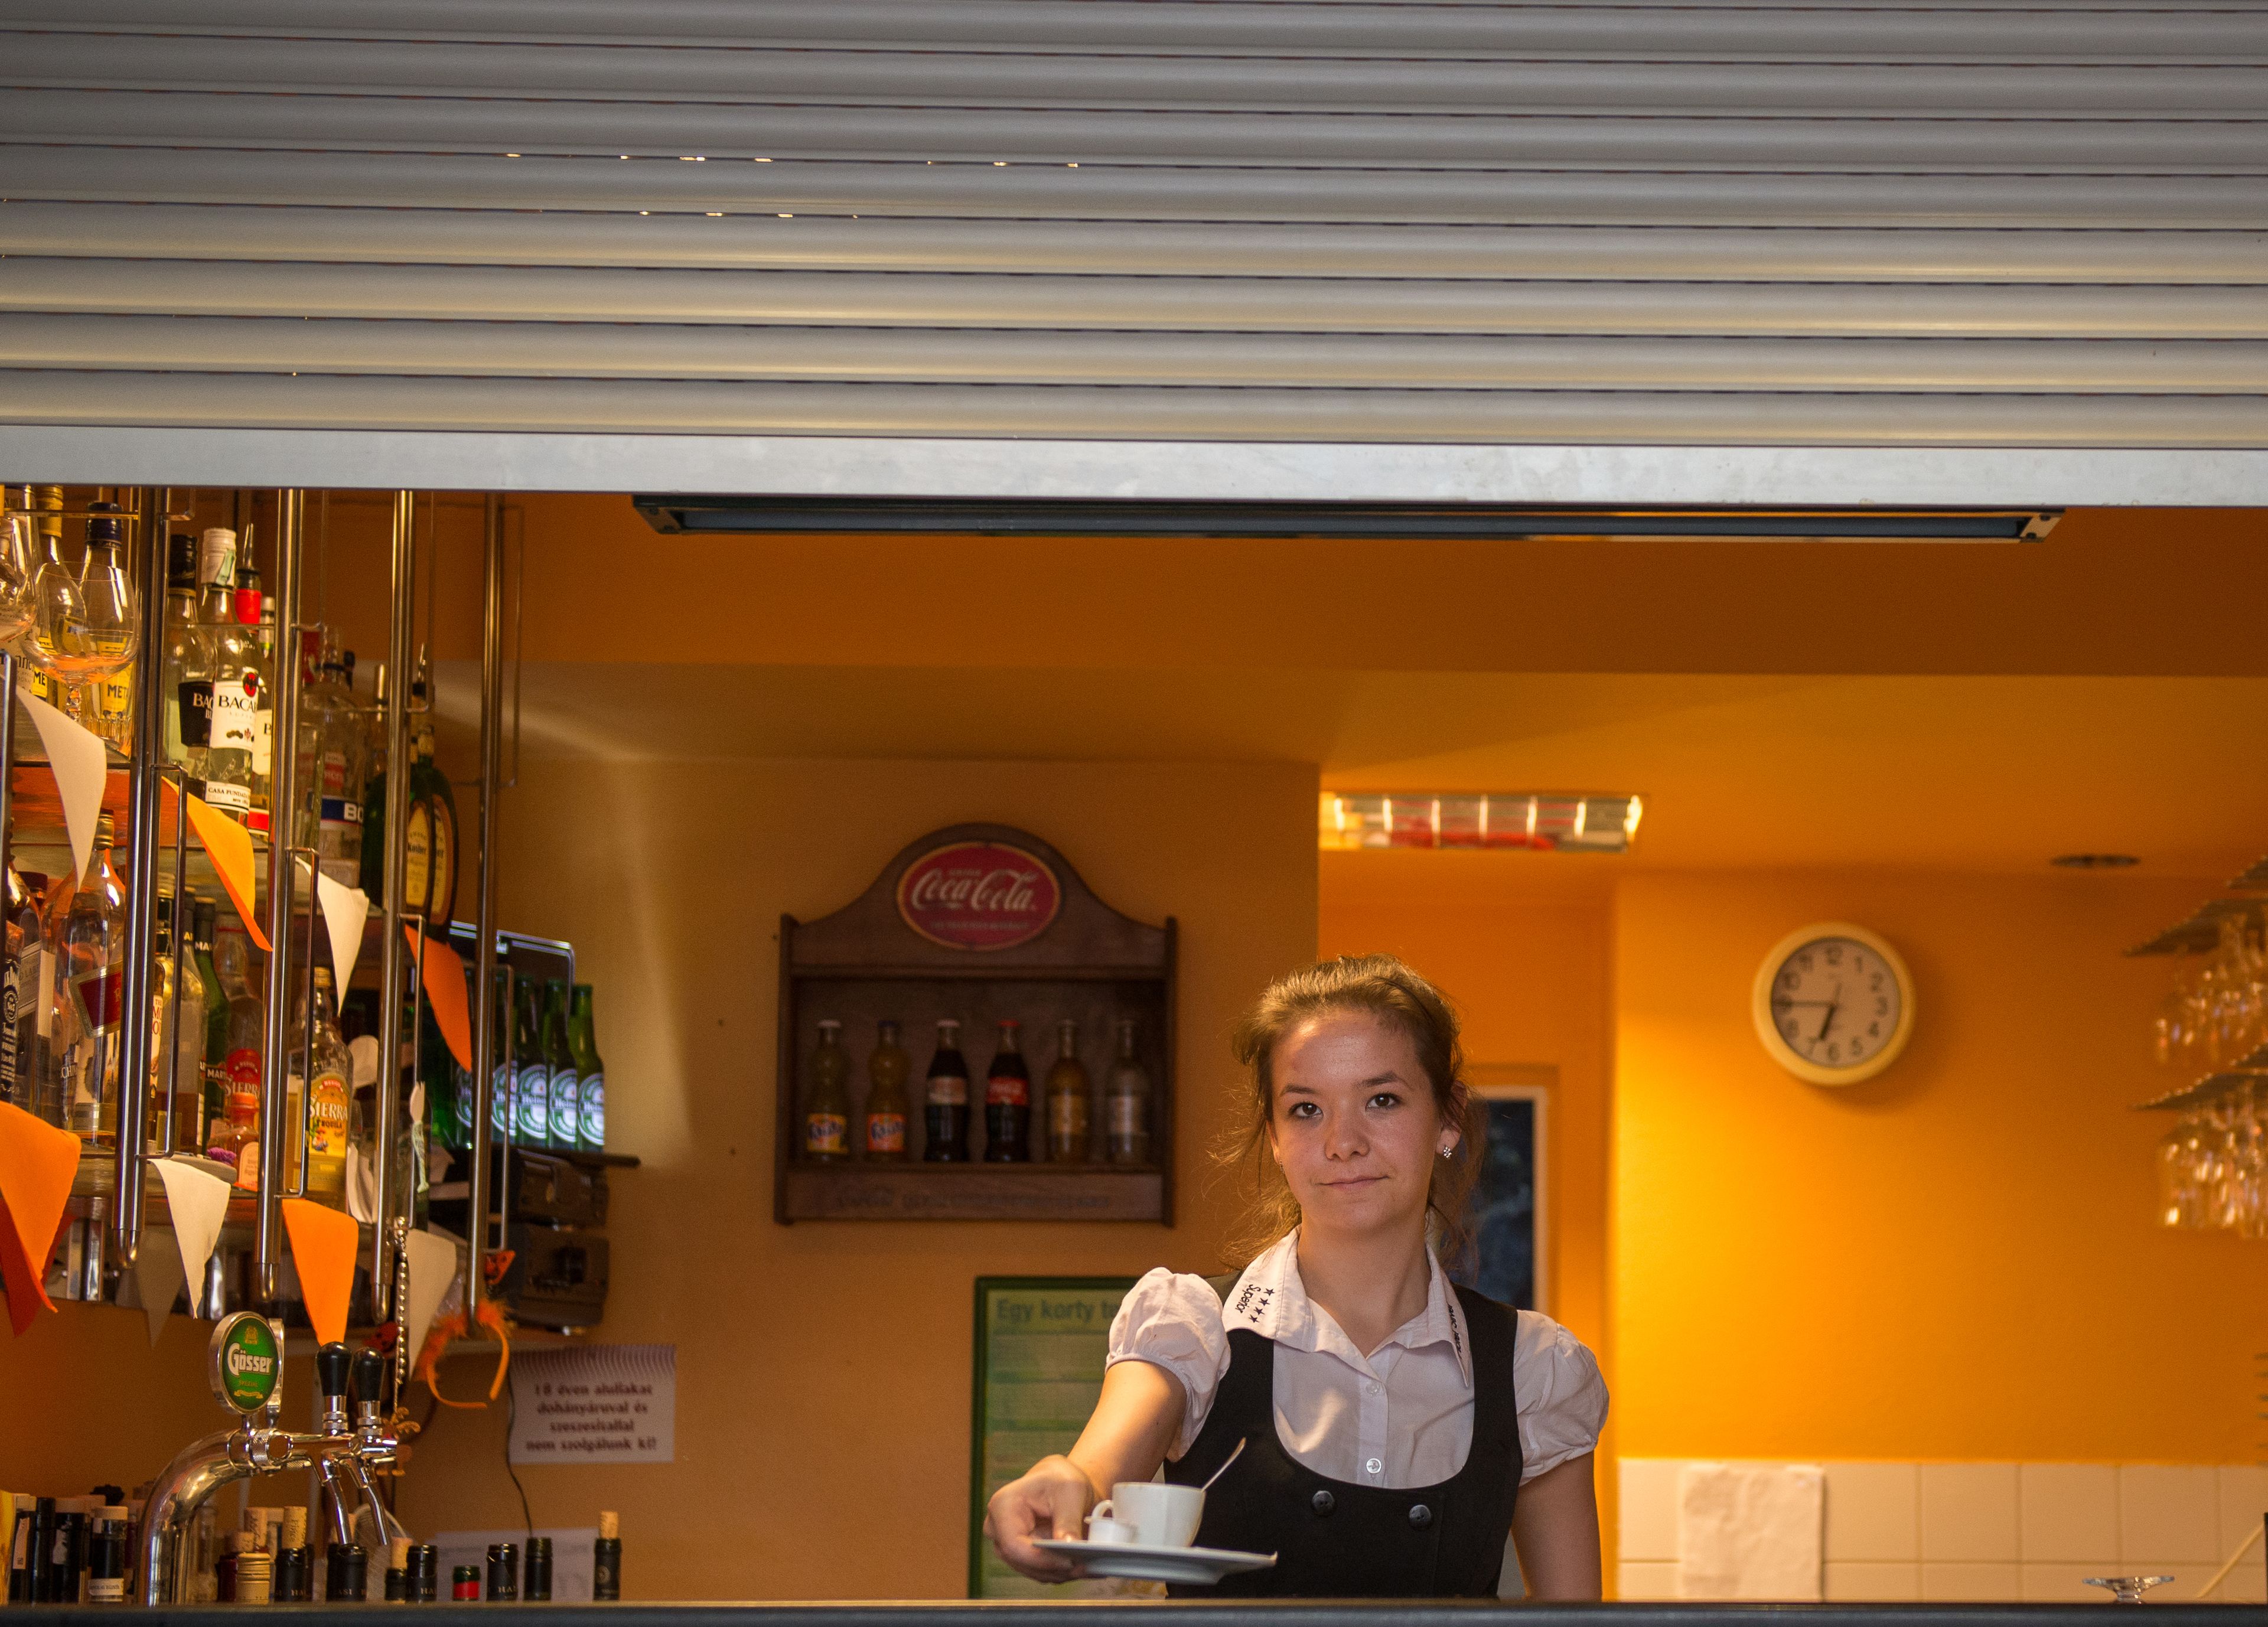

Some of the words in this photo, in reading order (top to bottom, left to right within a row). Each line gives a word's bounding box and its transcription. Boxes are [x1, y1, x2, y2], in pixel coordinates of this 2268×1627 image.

[911, 868, 1038, 911] Coca-Cola
[1235, 1284, 1262, 1314] Superior
[227, 1342, 274, 1377] Gösser
